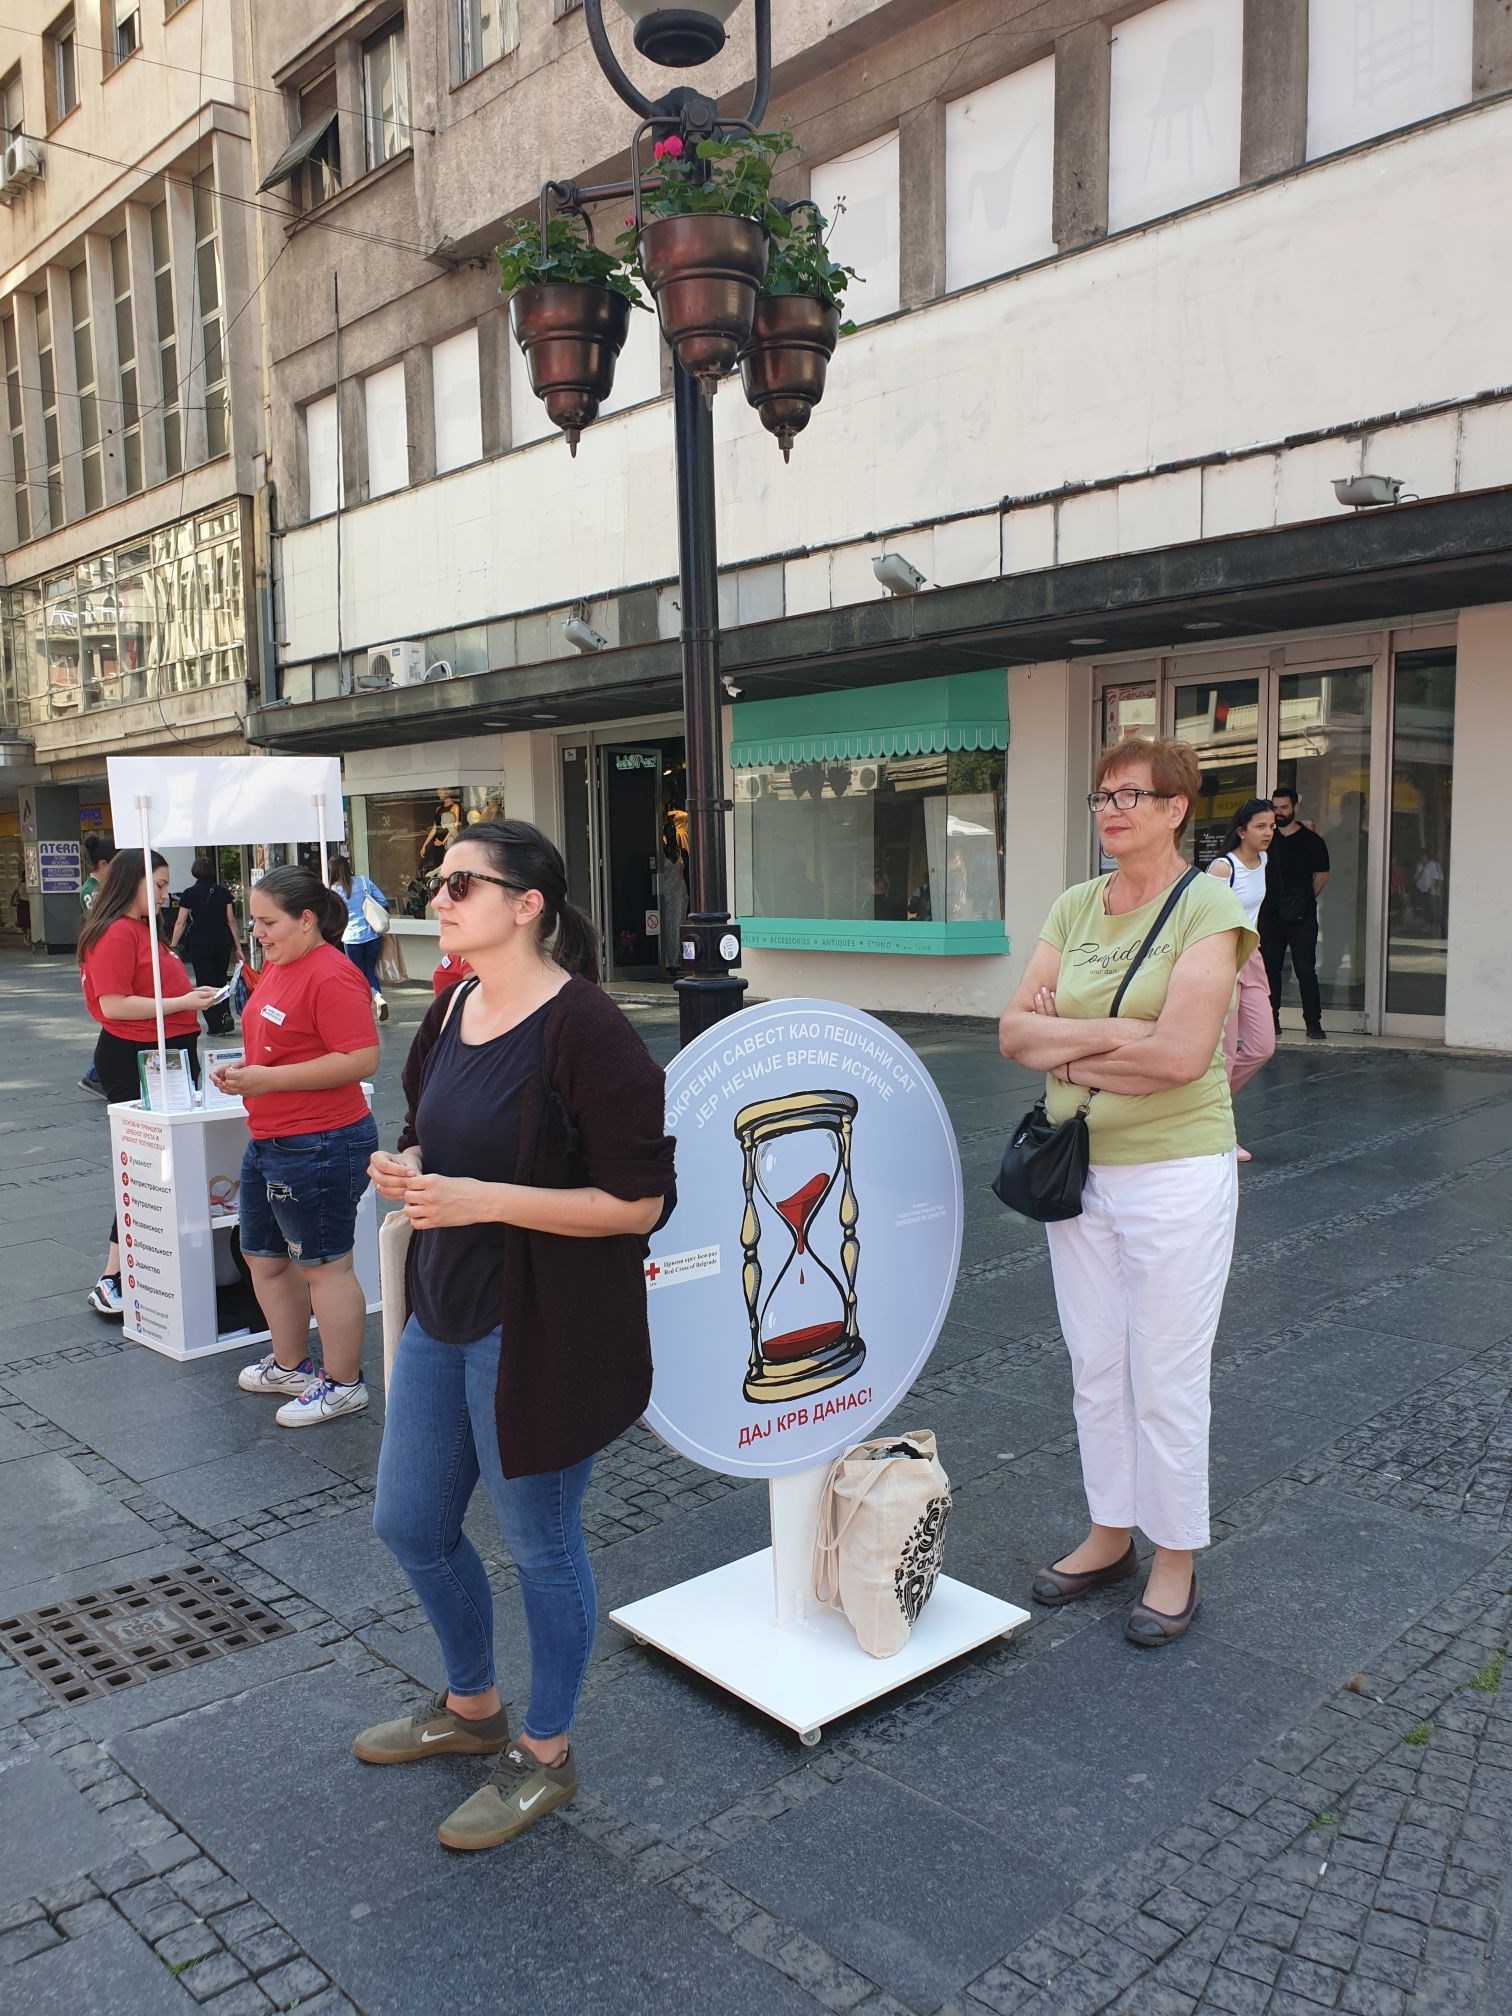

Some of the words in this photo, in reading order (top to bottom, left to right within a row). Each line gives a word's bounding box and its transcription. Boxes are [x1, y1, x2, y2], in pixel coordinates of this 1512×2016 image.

[769, 936, 810, 945] ACCESSORIES
[1068, 939, 1173, 968] Confidnce
[665, 1060, 721, 1128] ОКРЕНИ
[723, 1026, 785, 1066] САВЕСТ
[789, 1023, 820, 1039] КАО
[824, 1024, 893, 1069] ПЕШЧАНИ
[892, 1064, 917, 1093] САТ
[695, 1094, 720, 1129] ЈЕР
[721, 1053, 783, 1099] НЕЧИЈЕ
[787, 1049, 839, 1068] ВРЕМЕ
[841, 1055, 894, 1102] ИСТИЧЕ
[738, 1419, 772, 1449] ДАЈ
[777, 1408, 809, 1433] КРВ
[813, 1387, 872, 1425] ДАНАС!
